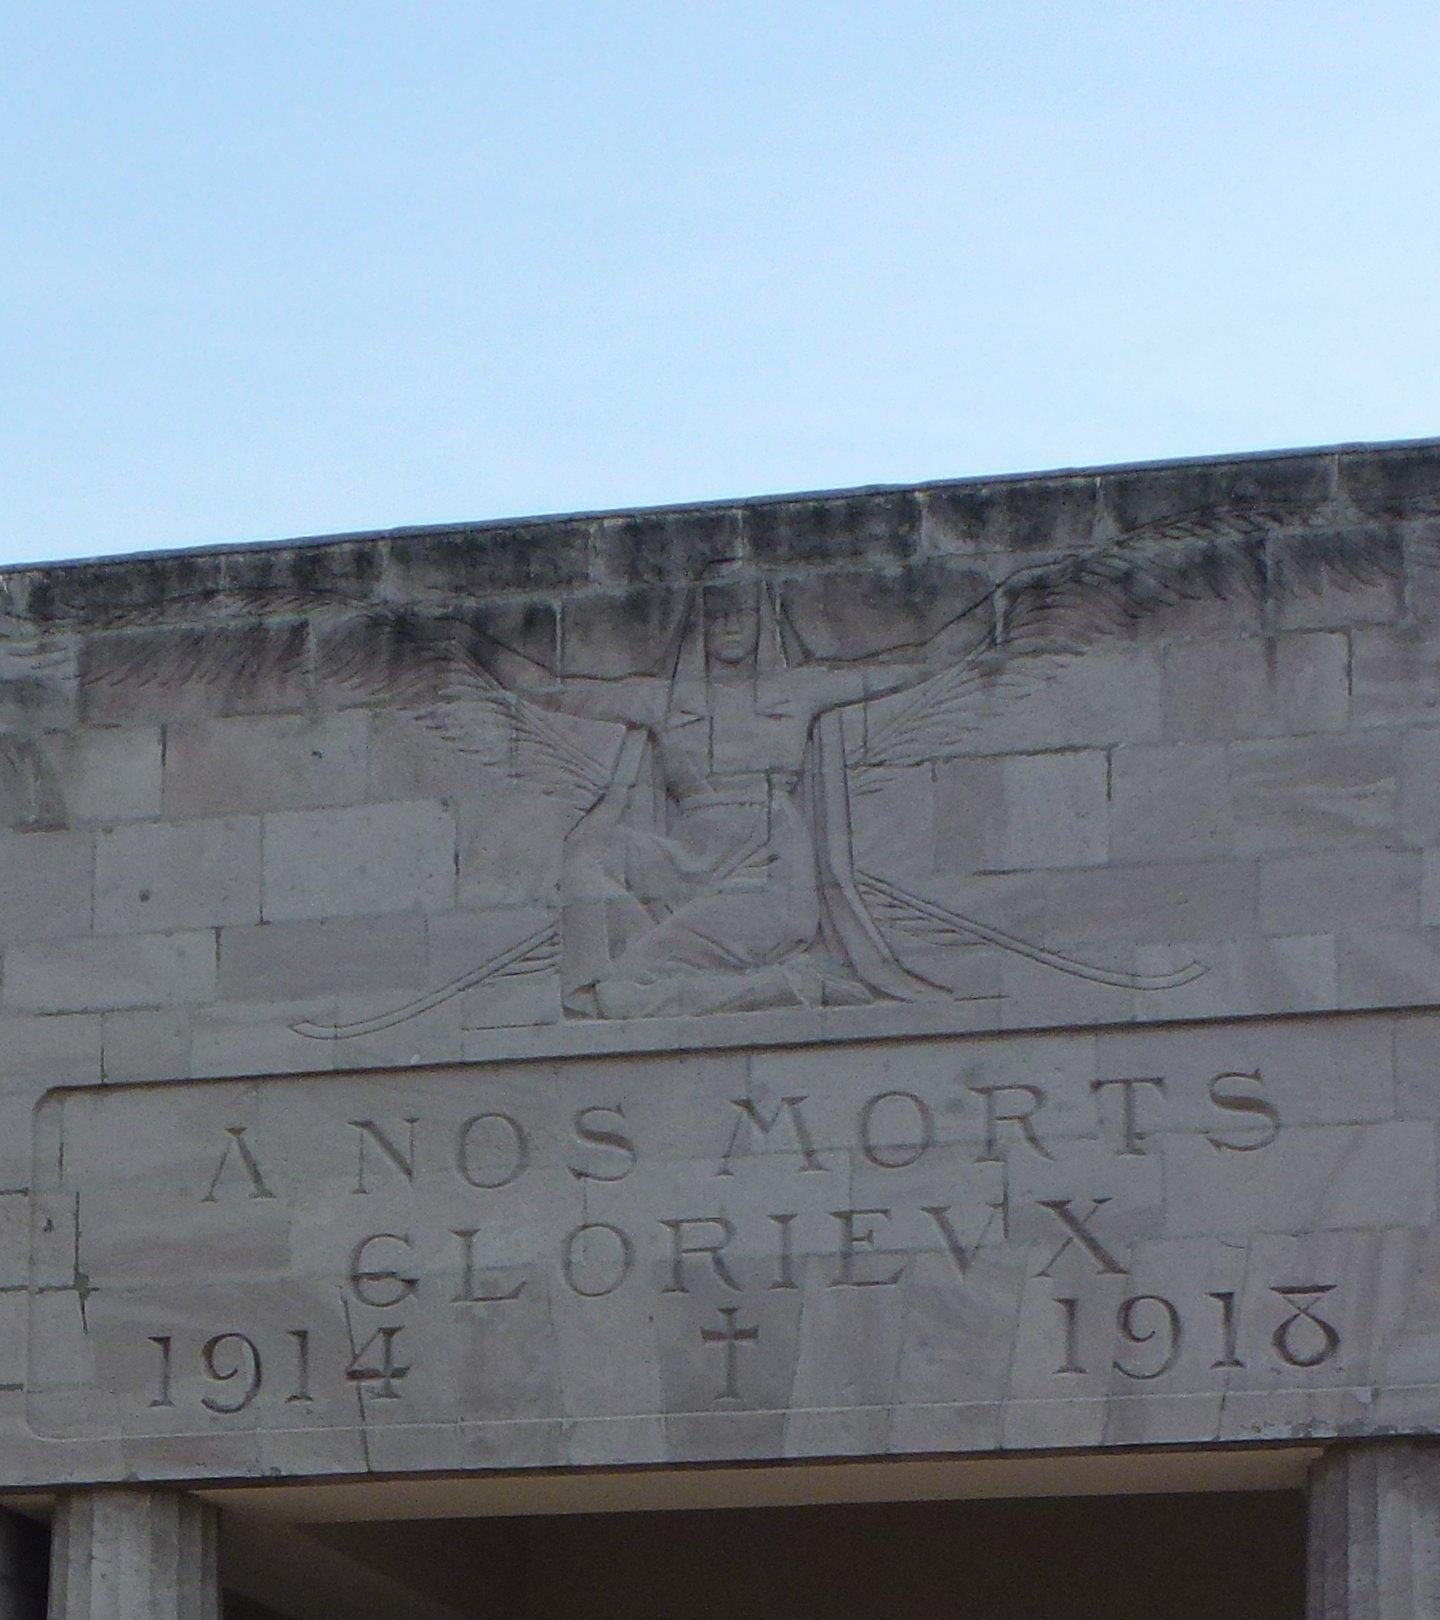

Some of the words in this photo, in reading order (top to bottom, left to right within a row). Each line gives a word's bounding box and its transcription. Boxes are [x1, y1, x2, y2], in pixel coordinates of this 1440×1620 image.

[202, 1127, 276, 1202] A
[346, 1102, 637, 1196] NOS
[714, 1068, 1281, 1177] MORTS
[349, 1197, 1130, 1308] GLORIEVX
[147, 1325, 411, 1414] 1914
[1052, 1284, 1341, 1381] 1918
